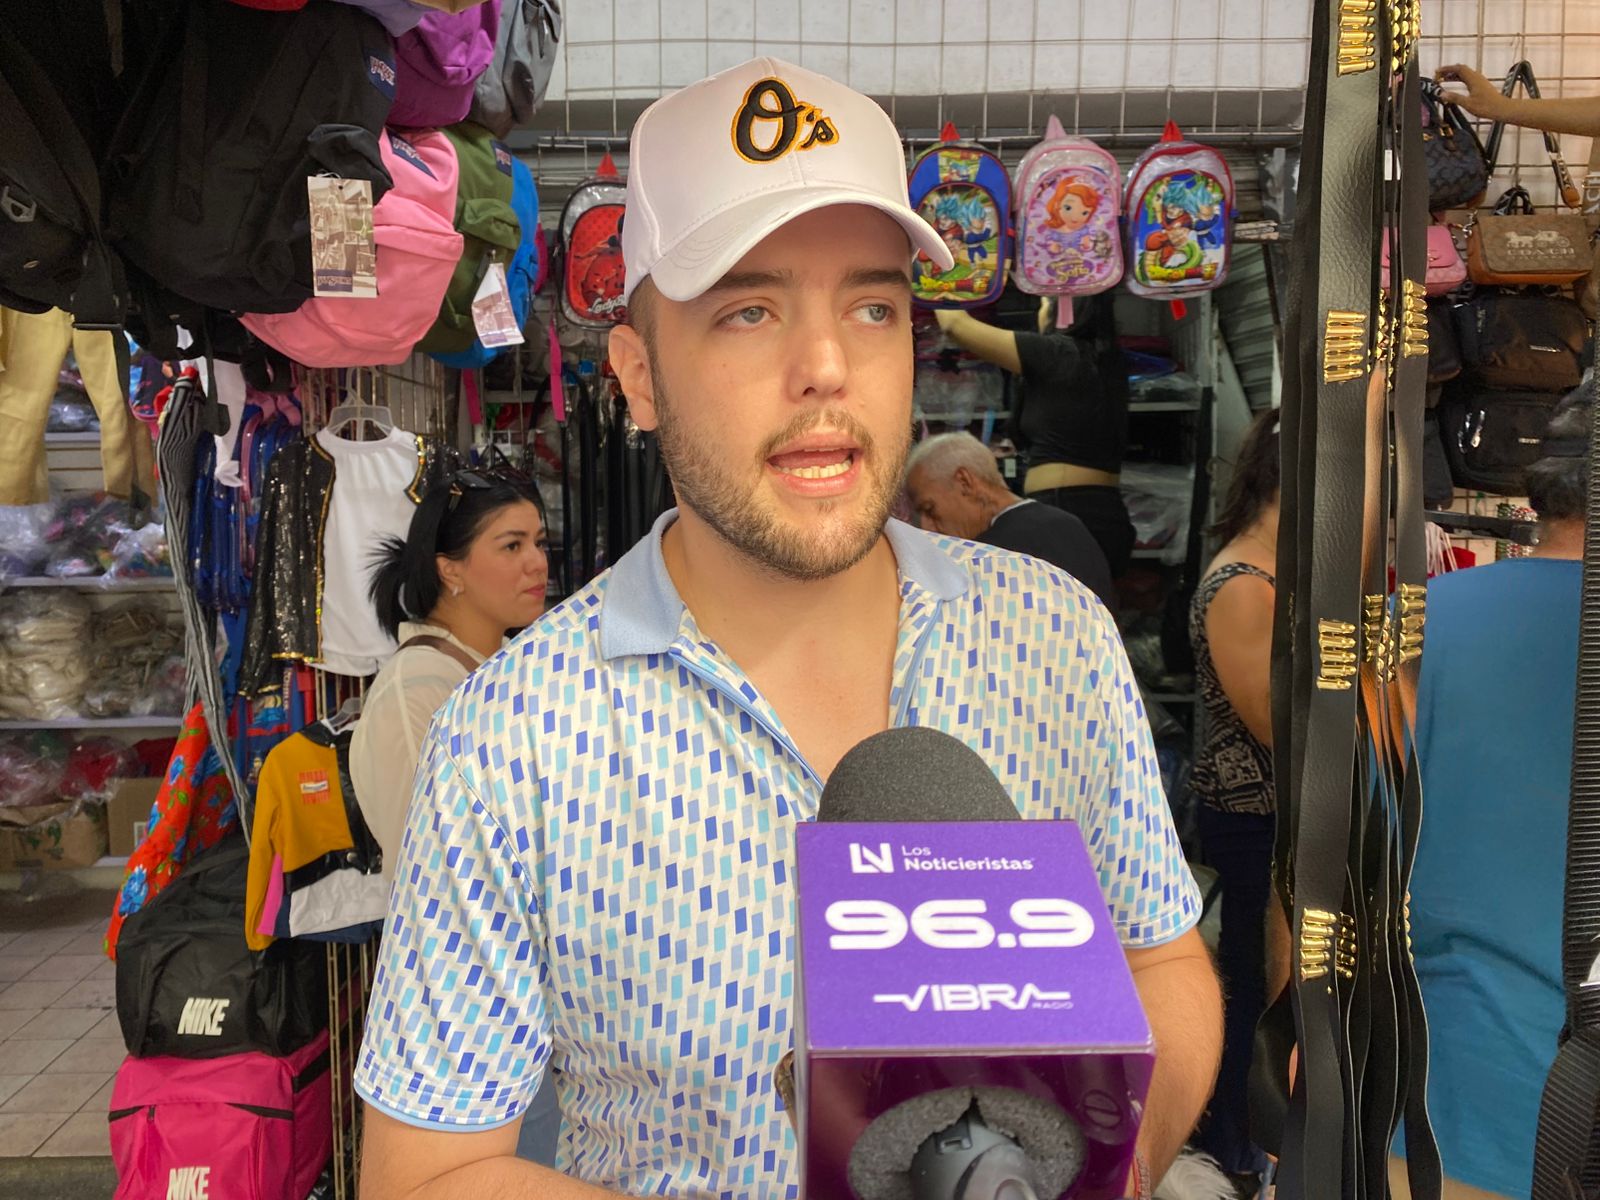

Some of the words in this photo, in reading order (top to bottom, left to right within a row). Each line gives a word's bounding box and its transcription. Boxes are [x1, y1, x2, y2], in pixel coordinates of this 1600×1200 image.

[731, 77, 839, 164] O's
[587, 294, 628, 314] LadyB
[903, 857, 1034, 871] Noticieristas
[825, 898, 1095, 950] 96.9
[873, 983, 1071, 1012] VIBRA
[177, 997, 230, 1036] NIKE
[166, 1166, 211, 1200] NIKE
